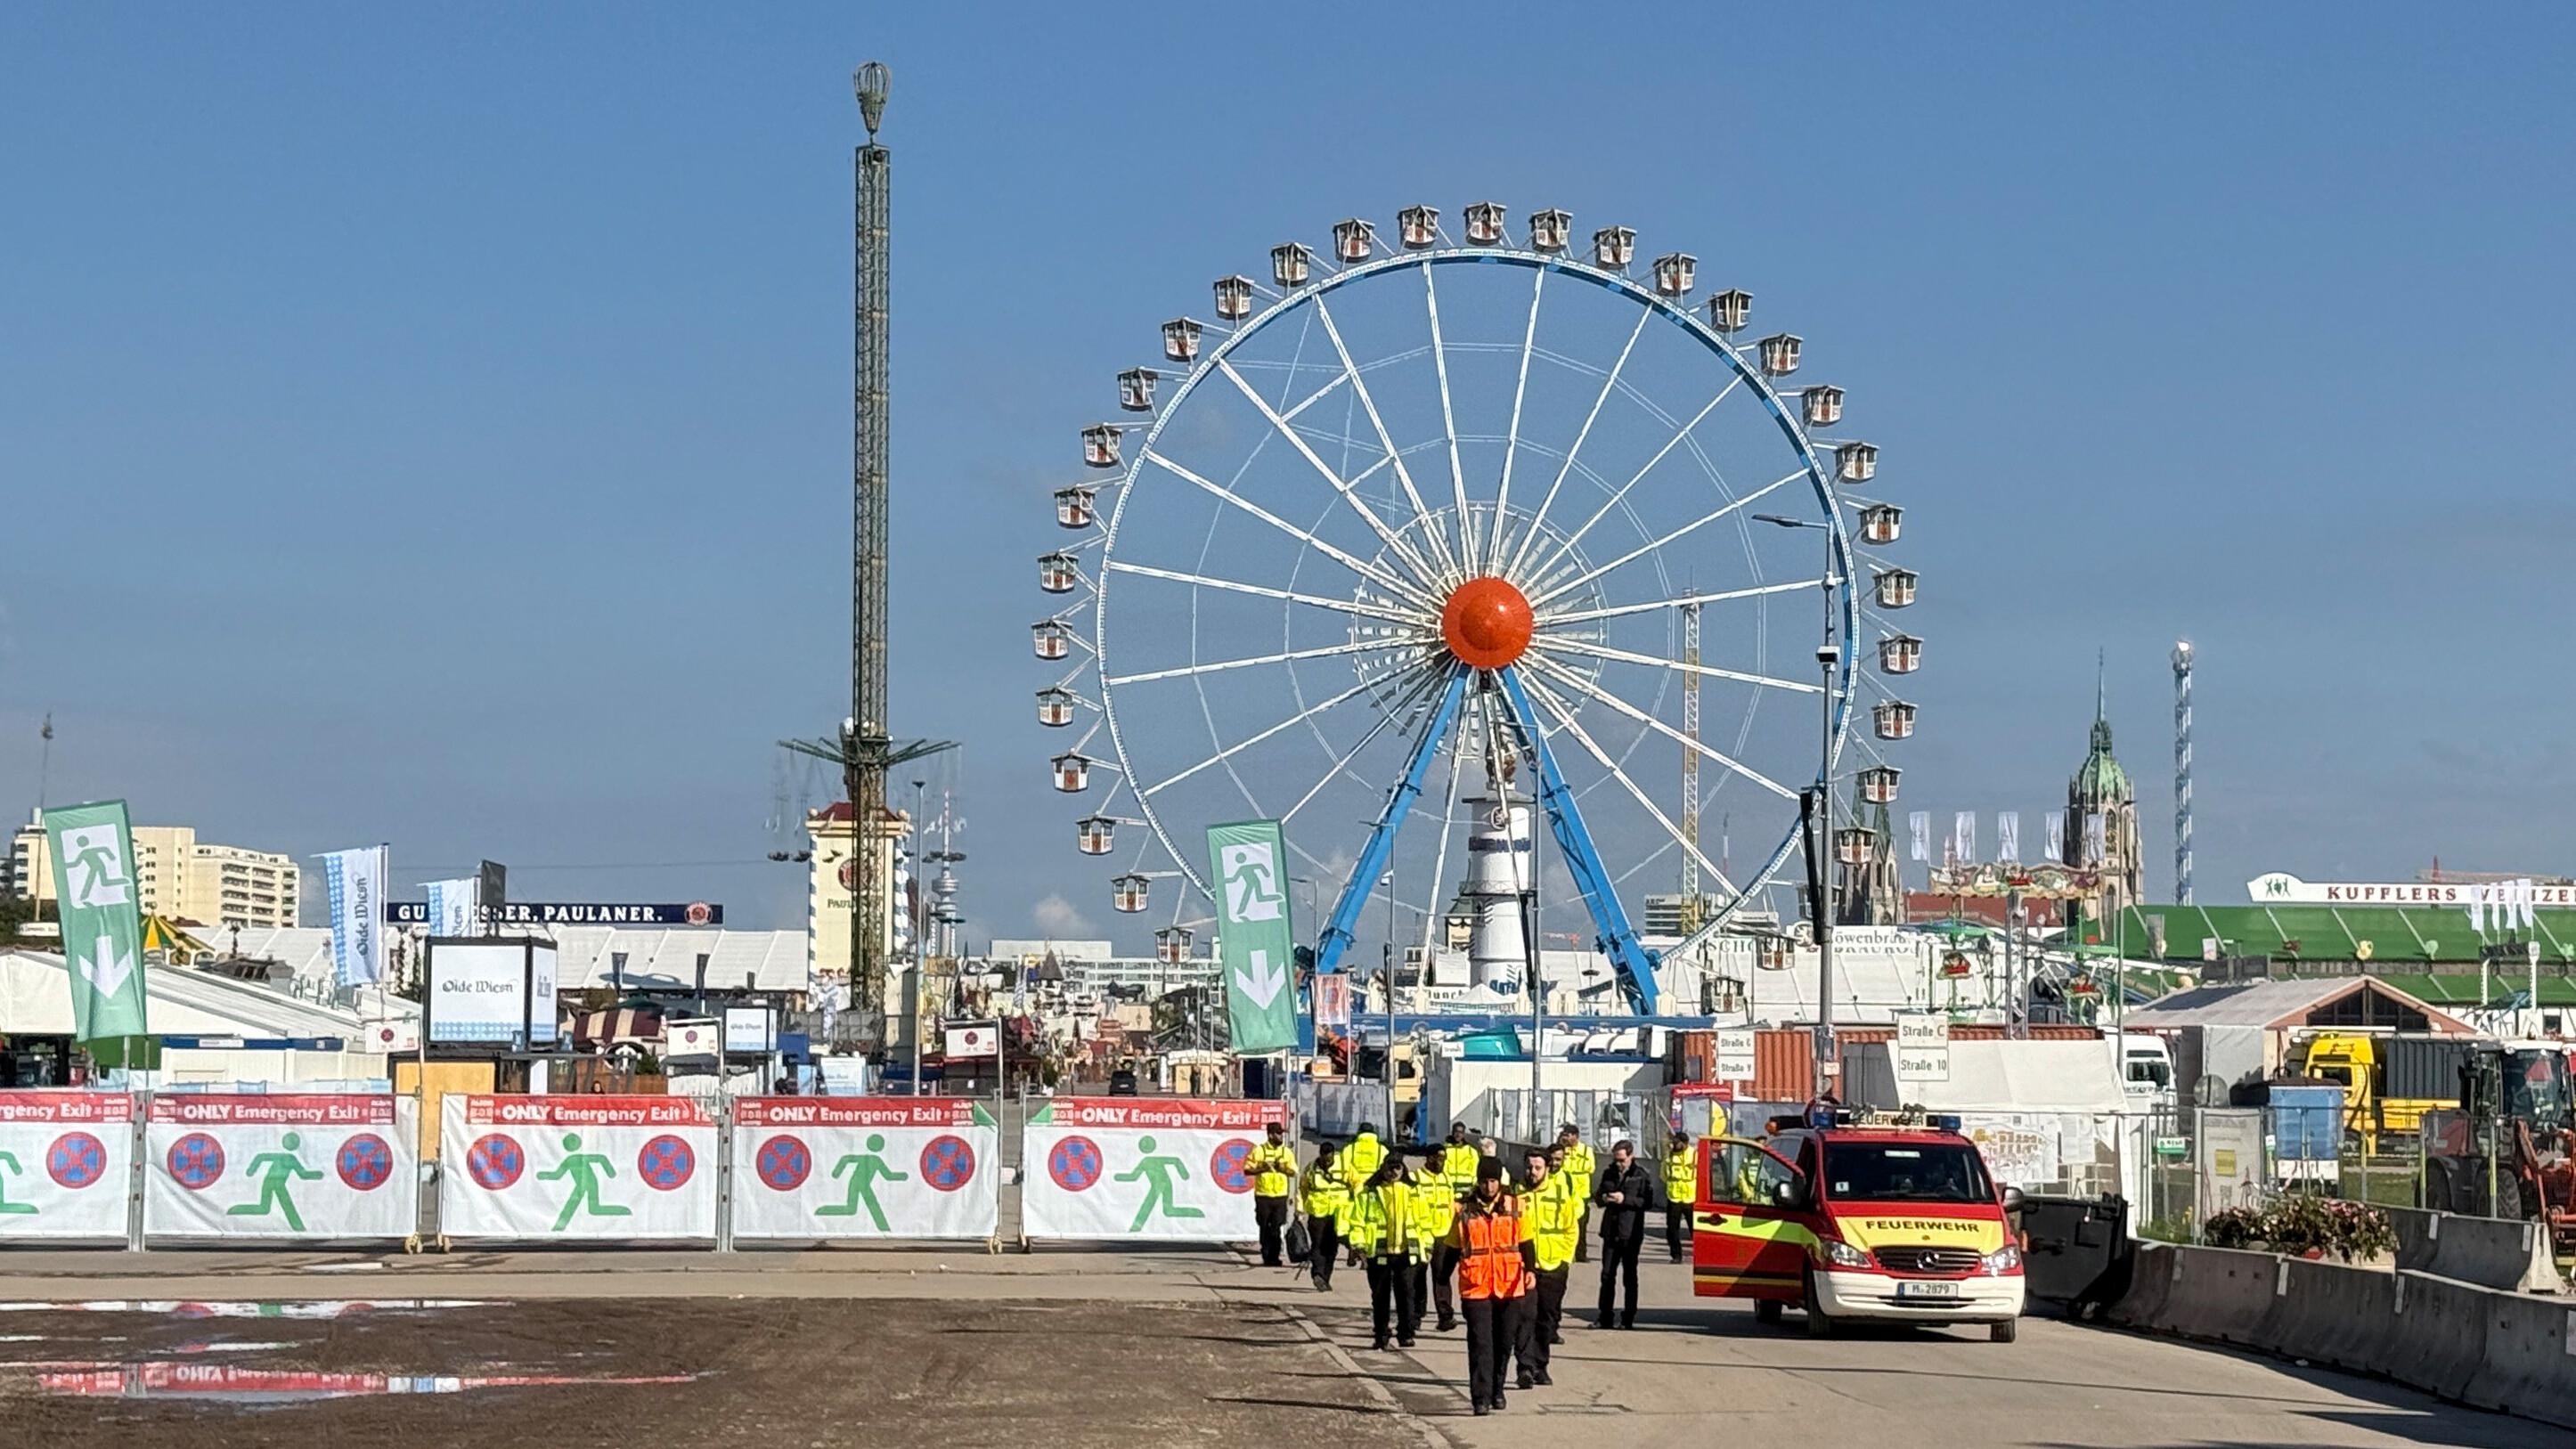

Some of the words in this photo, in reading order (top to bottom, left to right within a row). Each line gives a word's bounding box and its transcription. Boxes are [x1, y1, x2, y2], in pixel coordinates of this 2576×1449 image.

[543, 905, 664, 922] PAULANER.
[1902, 1024, 1934, 1037] Straße
[1936, 1024, 1946, 1037] C
[1900, 1059, 1932, 1071] Straße
[1936, 1059, 1948, 1071] 10
[60, 1102, 93, 1118] Exit
[184, 1104, 232, 1119] ONLY
[234, 1104, 325, 1123] Emergency
[329, 1104, 360, 1119] Exit
[501, 1104, 551, 1120] ONLY
[554, 1106, 647, 1124] Emergency
[650, 1105, 681, 1121] Exit
[769, 1106, 818, 1122] ONLY
[819, 1107, 909, 1125] Emergency
[912, 1106, 942, 1122] Exit
[1081, 1107, 1129, 1124] ONLY
[1130, 1108, 1219, 1128] Emergency
[1222, 1110, 1251, 1126] Exit
[1865, 1220, 1979, 1233] FEUERWEHR
